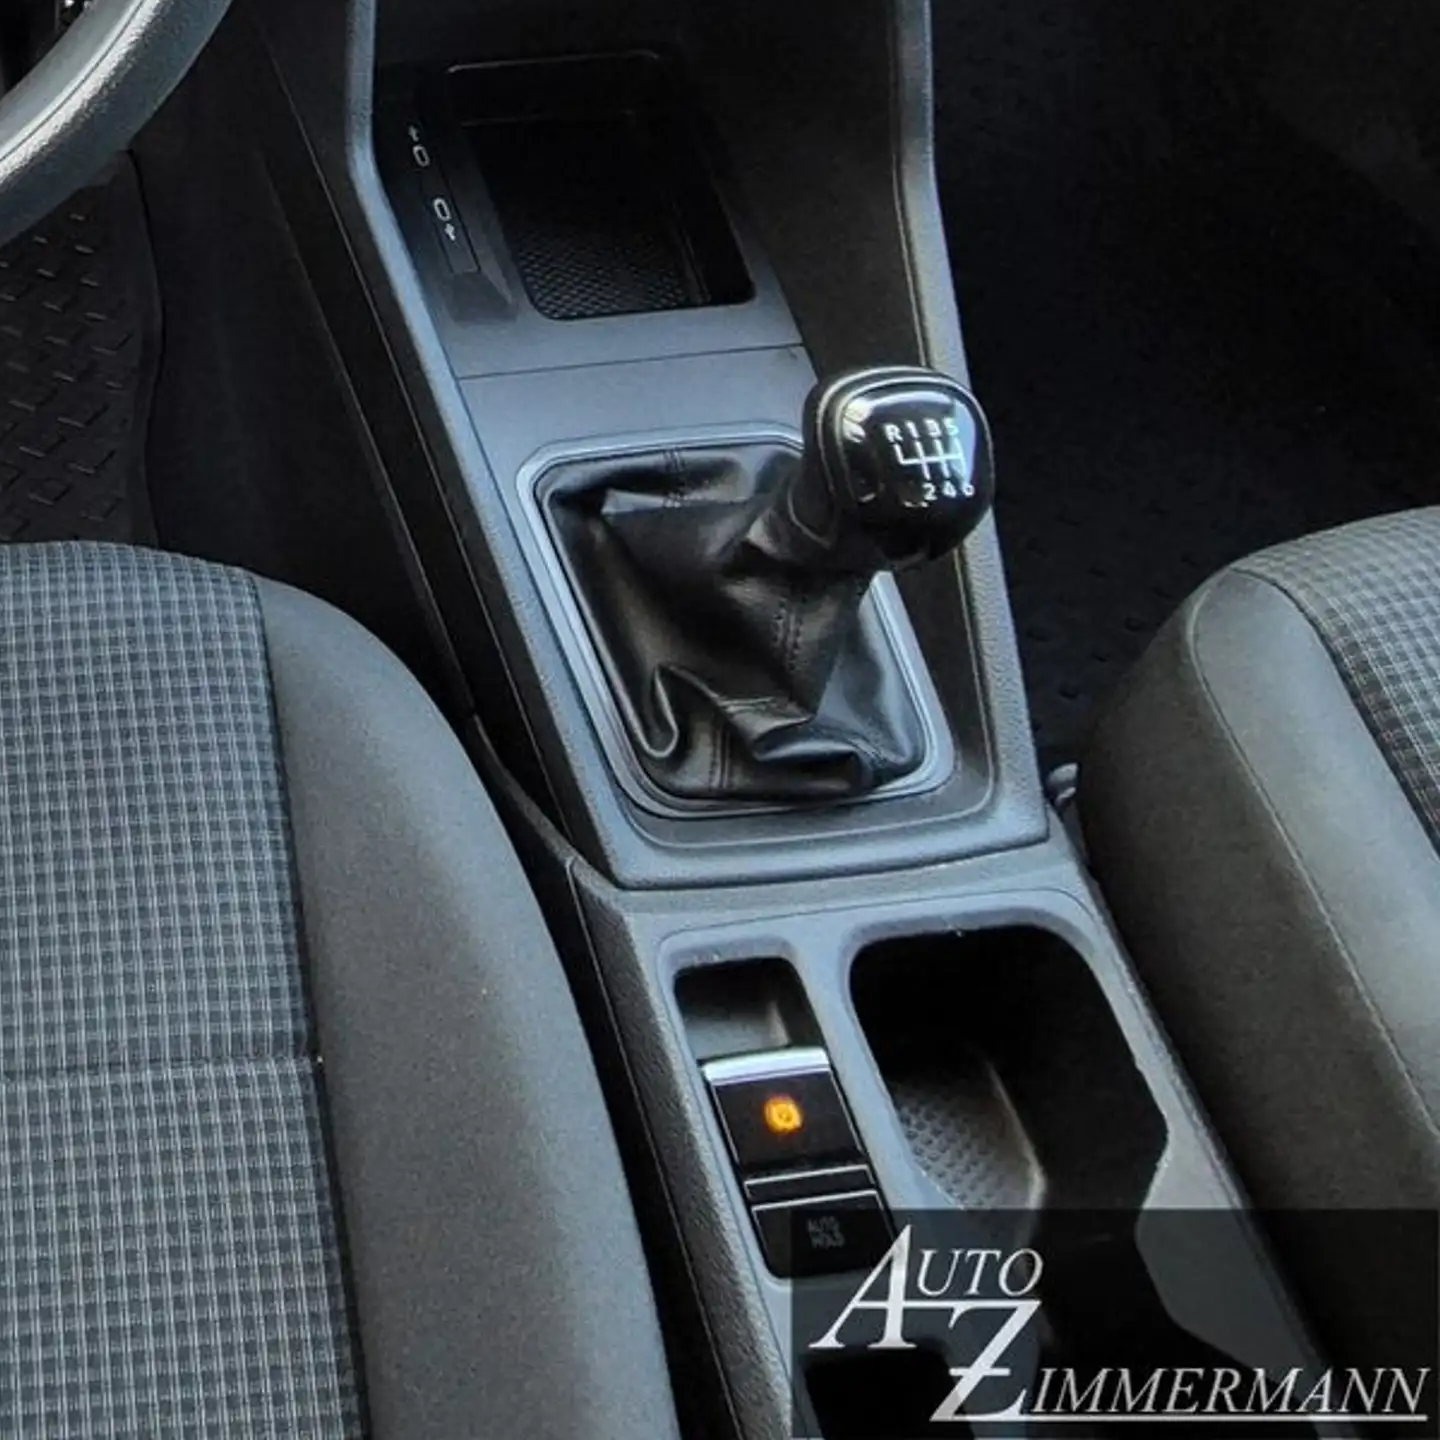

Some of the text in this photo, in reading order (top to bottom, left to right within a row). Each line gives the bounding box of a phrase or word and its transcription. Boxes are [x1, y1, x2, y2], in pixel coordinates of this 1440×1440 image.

[884, 417, 960, 442] R 1 3 5
[922, 483, 938, 501] 2
[942, 480, 958, 498] 4
